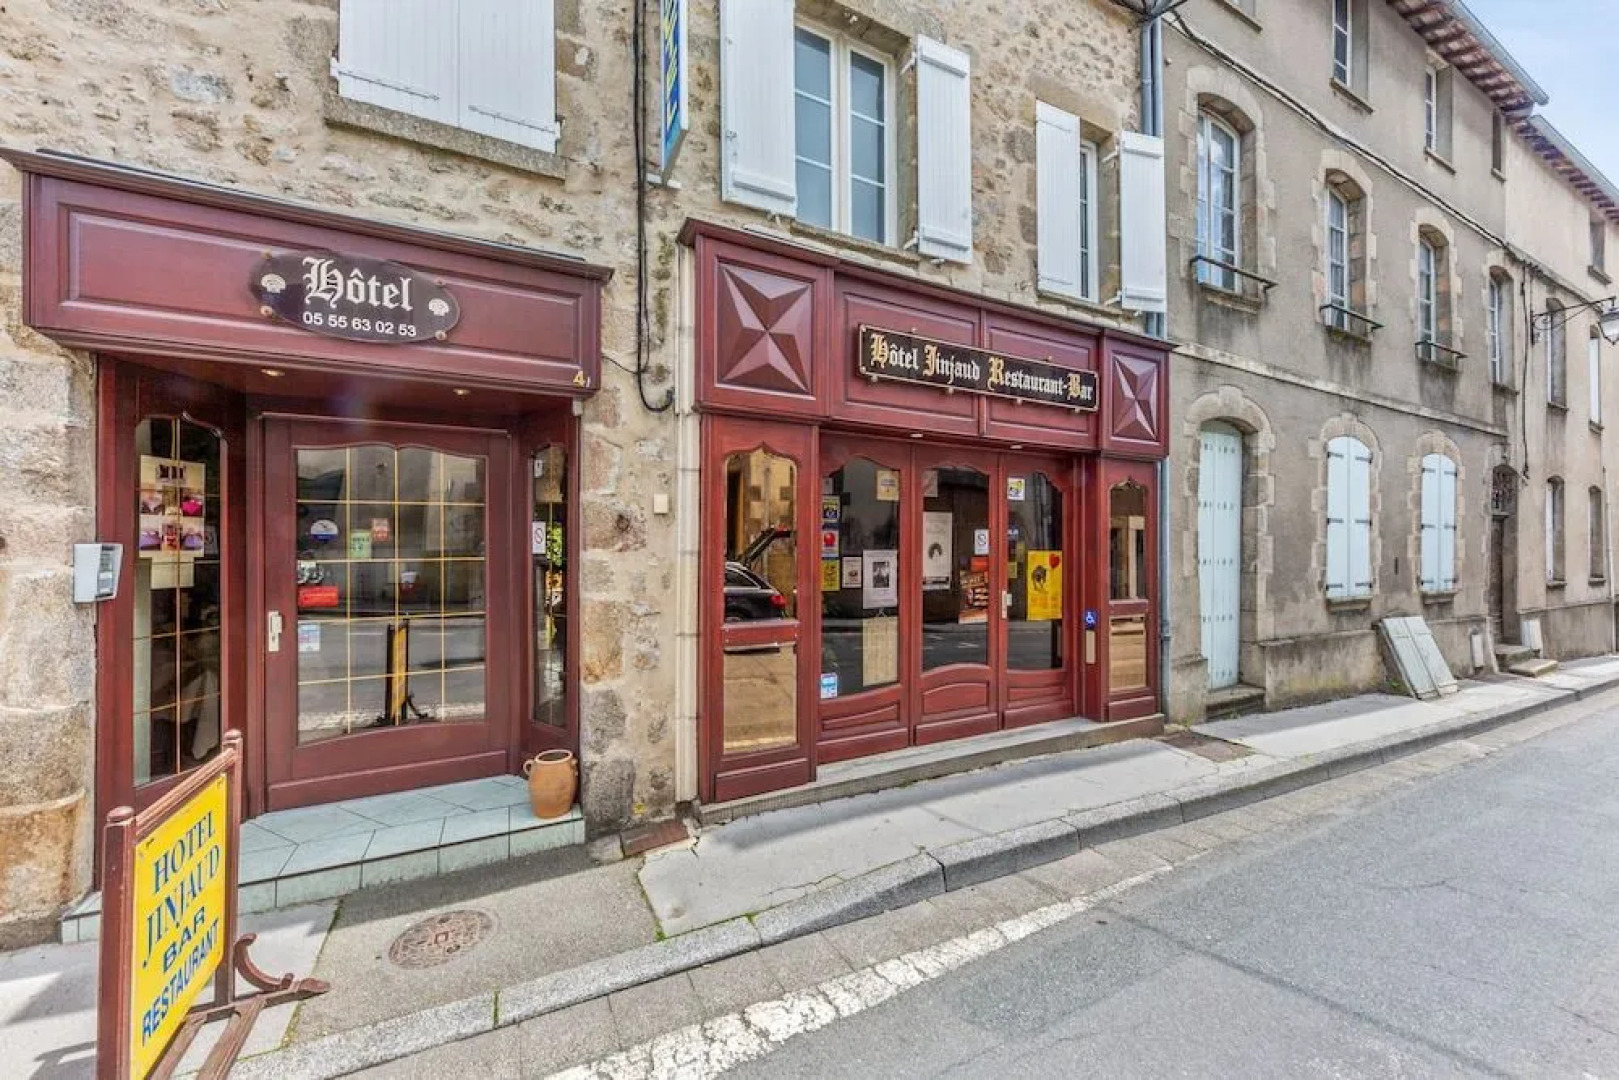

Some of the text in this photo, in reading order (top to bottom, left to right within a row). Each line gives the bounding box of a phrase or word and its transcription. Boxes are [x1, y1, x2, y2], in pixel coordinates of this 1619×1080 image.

[302, 256, 414, 311] Hôtel
[302, 311, 417, 337] 05 55 63 02 53
[870, 333, 919, 370] Hôtel
[987, 356, 1094, 401] Restaurant-Bar
[154, 811, 215, 894] HOTEL
[142, 844, 220, 968] JINJAUD
[163, 906, 205, 973] BAR
[142, 918, 219, 1046] RESTAURANT
